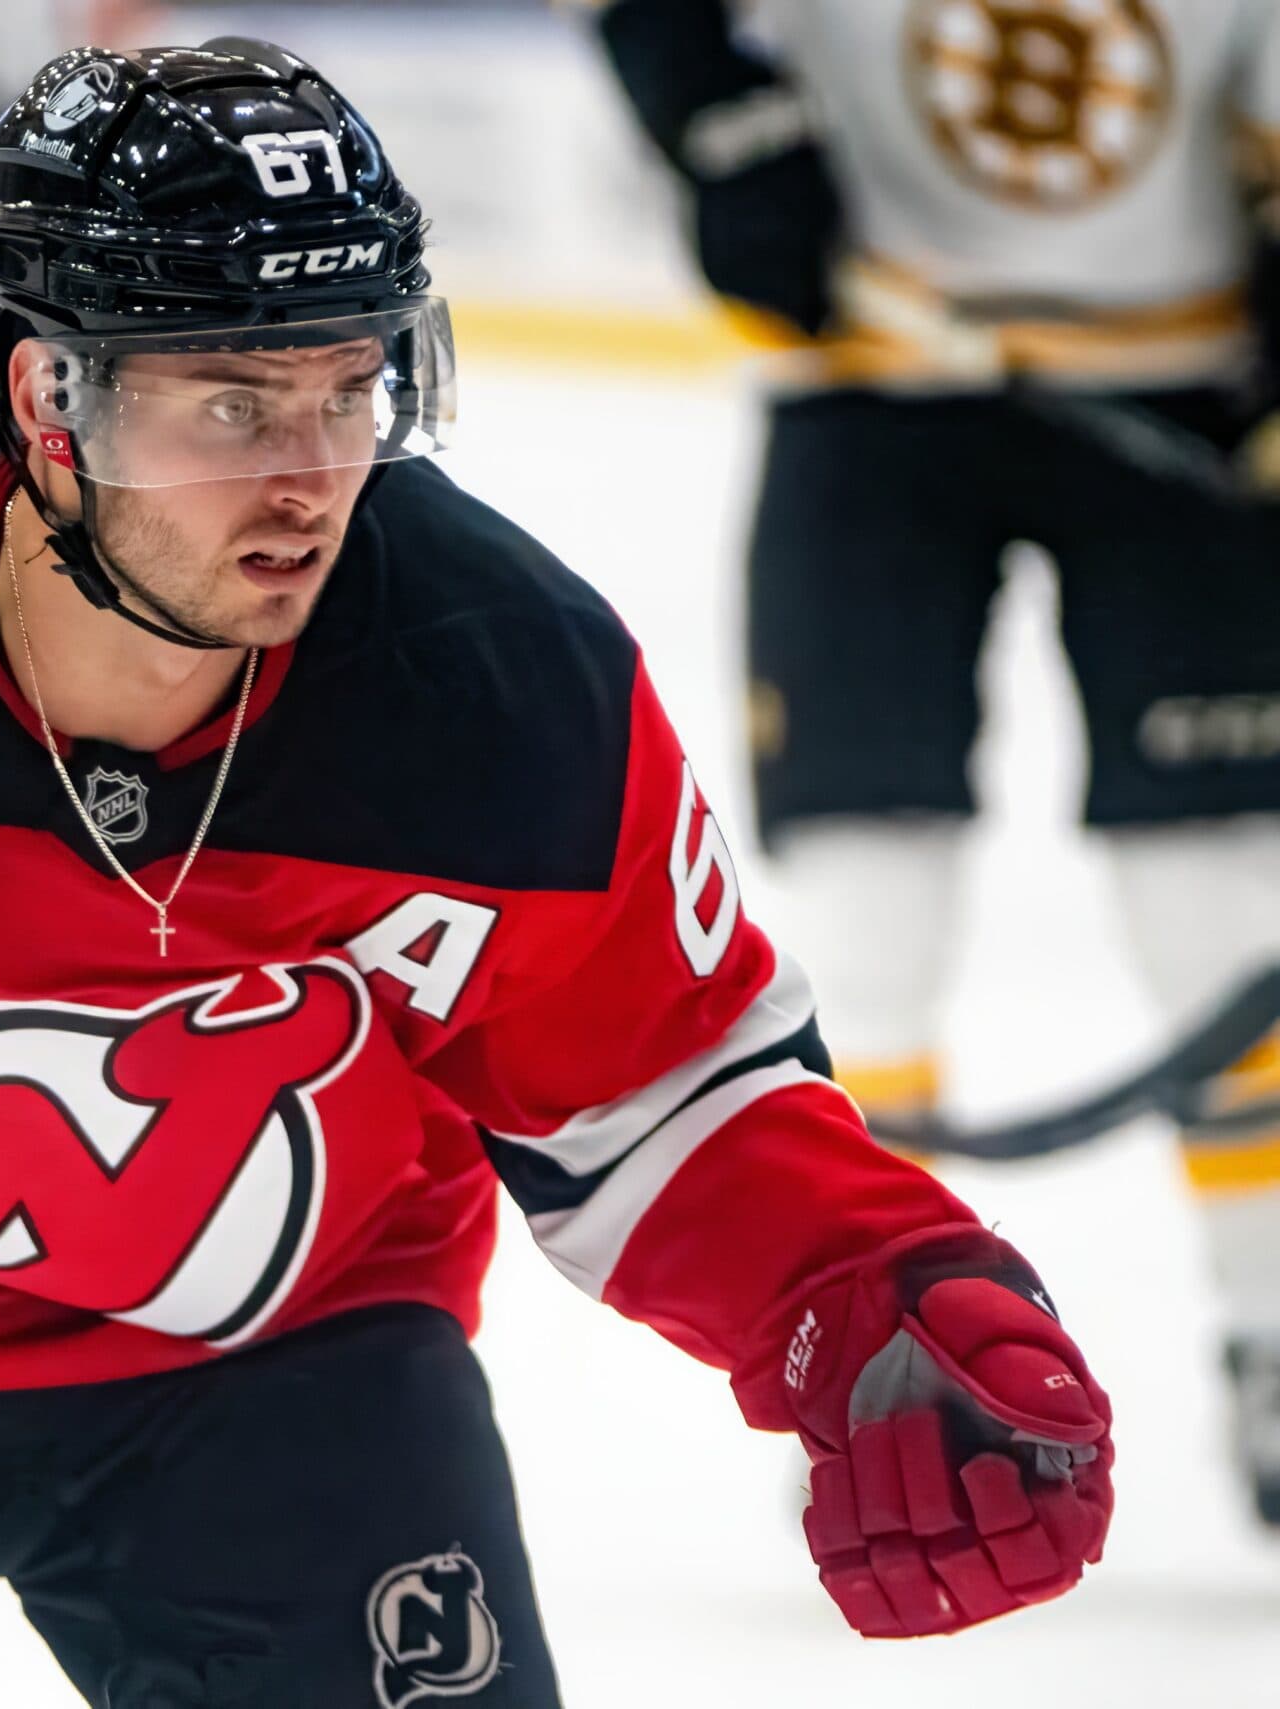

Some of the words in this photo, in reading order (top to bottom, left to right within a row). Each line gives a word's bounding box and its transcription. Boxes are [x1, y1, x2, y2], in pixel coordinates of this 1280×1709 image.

[241, 130, 348, 197] 67
[258, 241, 386, 279] CCM
[97, 792, 136, 824] NHL
[344, 892, 501, 1024] A
[784, 1308, 817, 1389] CCM
